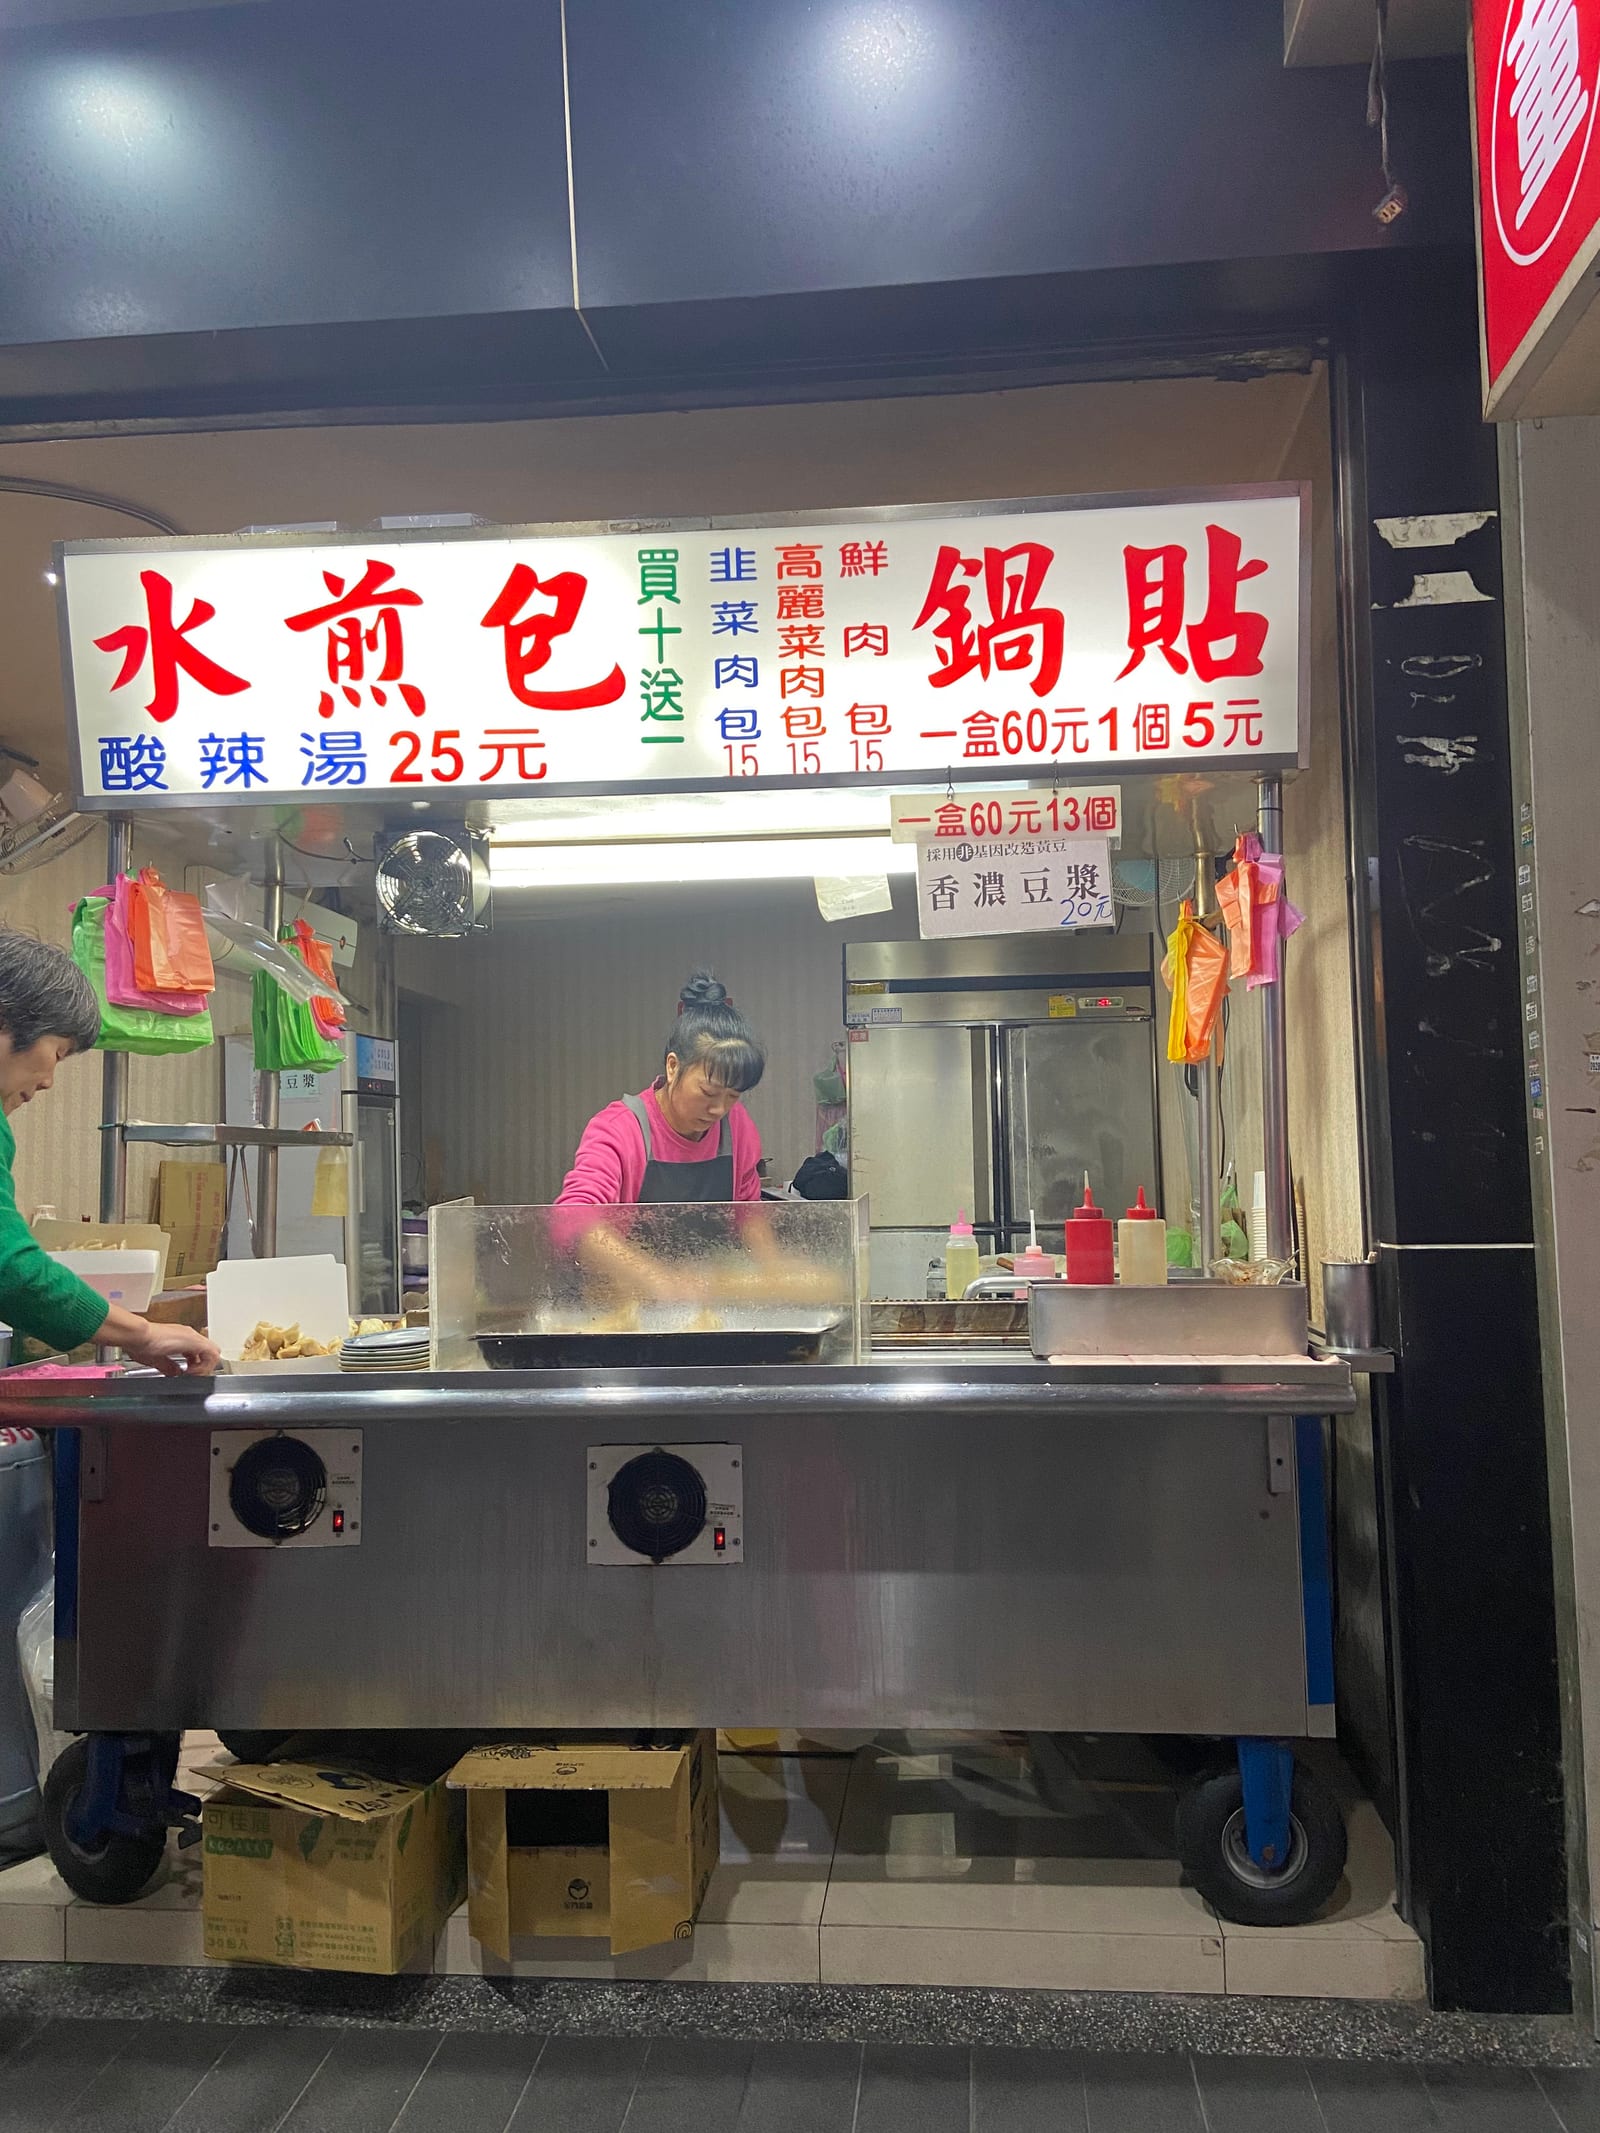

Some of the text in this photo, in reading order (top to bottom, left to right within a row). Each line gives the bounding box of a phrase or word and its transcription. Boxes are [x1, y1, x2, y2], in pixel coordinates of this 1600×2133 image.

[93, 559, 627, 723] 水煎包
[637, 549, 685, 743] 買十送一
[710, 547, 762, 776] 韭菜肉包 15
[774, 543, 827, 774] 高麗菜肉包 15
[839, 540, 892, 771] 鮮肉包 15
[911, 524, 1268, 697] 鍋貼
[898, 796, 1117, 838] 一盒60元13個
[926, 863, 1101, 912] 香濃豆漿
